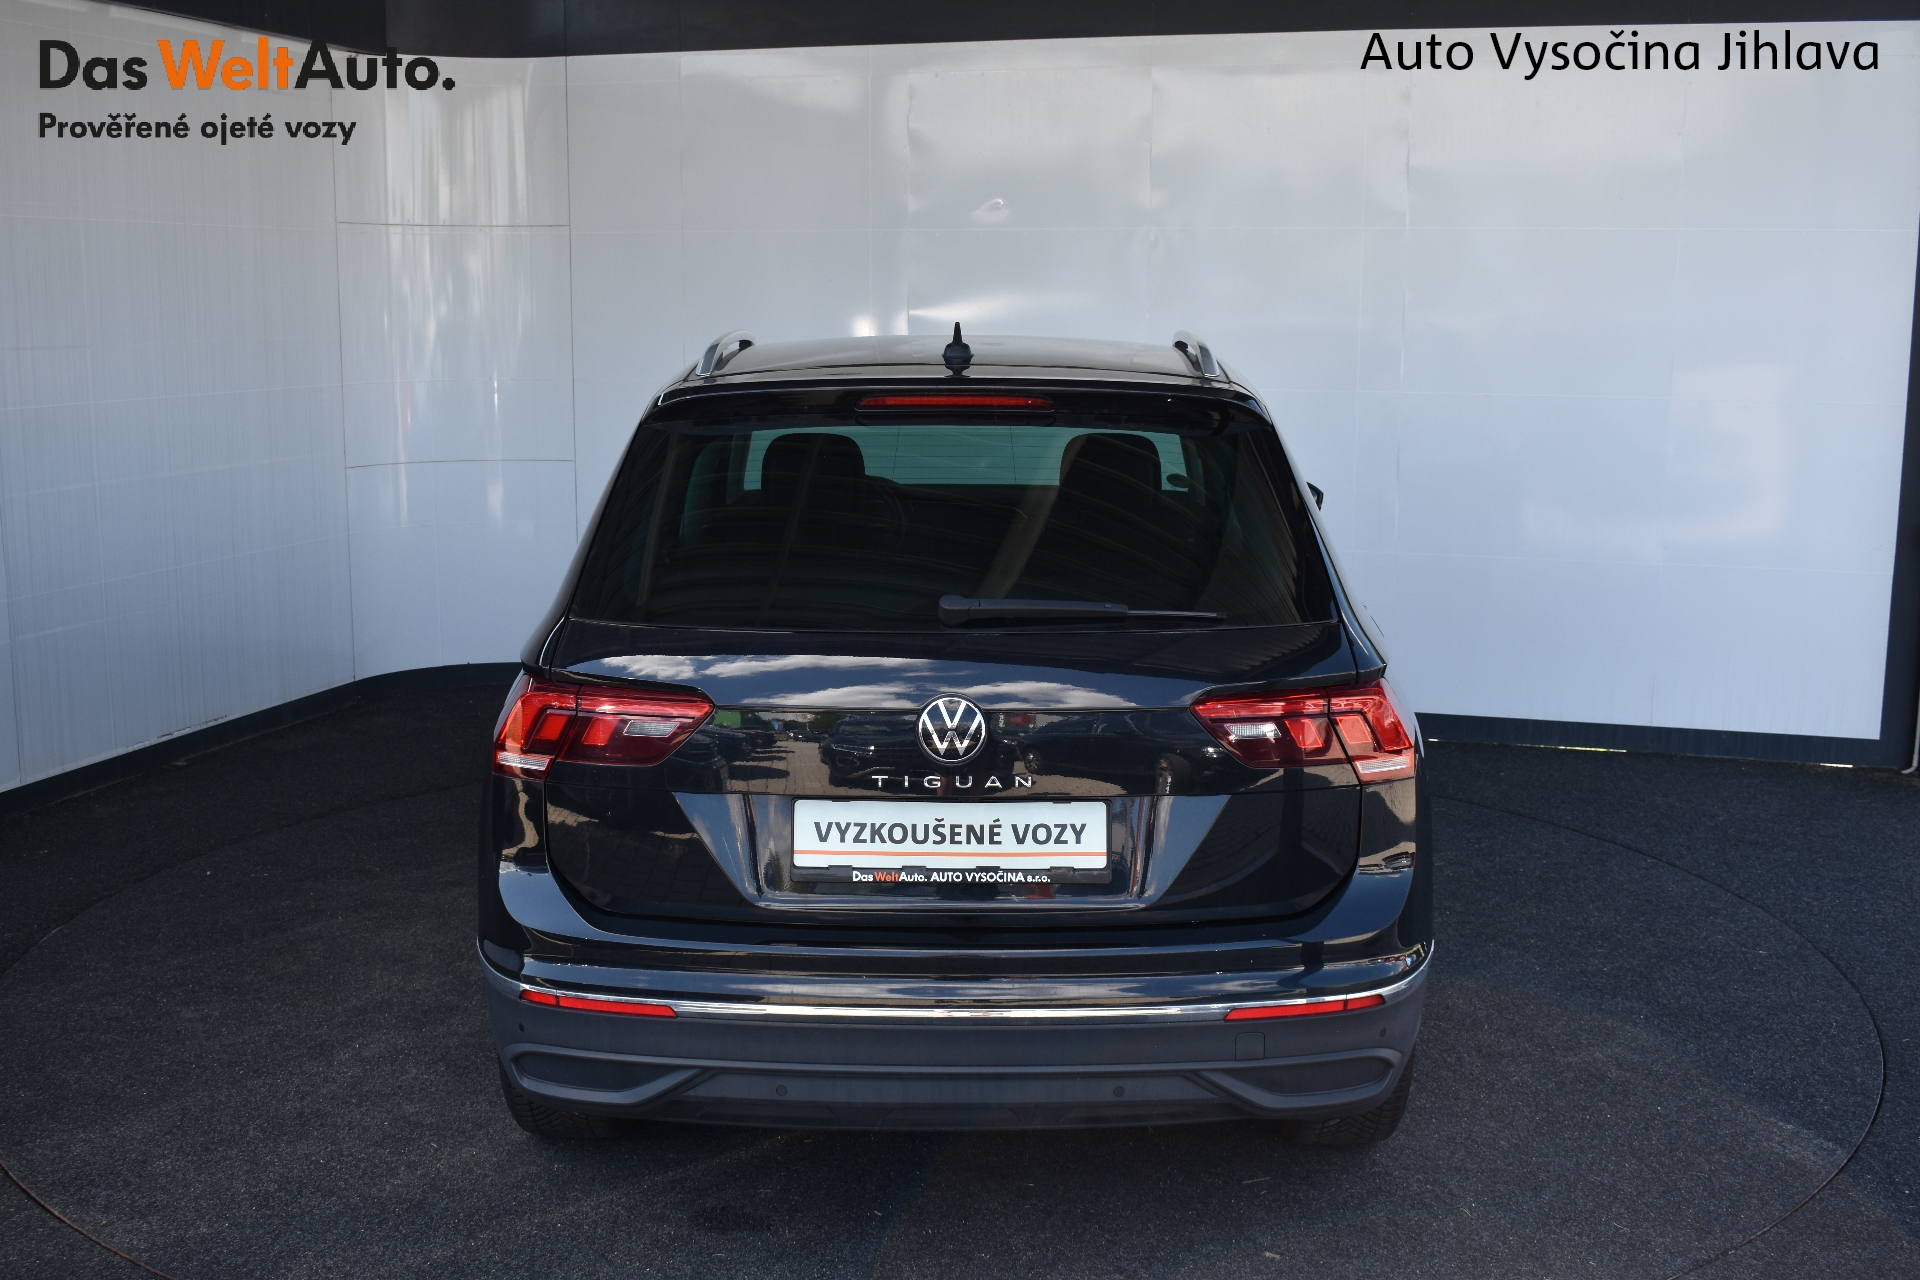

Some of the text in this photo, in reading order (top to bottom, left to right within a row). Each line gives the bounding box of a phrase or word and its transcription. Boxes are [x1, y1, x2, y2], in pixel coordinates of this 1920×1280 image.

[919, 697, 985, 760] VW
[871, 774, 1034, 789] TIGUAN
[814, 818, 1087, 845] VYZKOUŠENÉ VOZY
[852, 869, 1051, 883] Das WeltAuto. AUTO VYSOČINA s.r.o.
